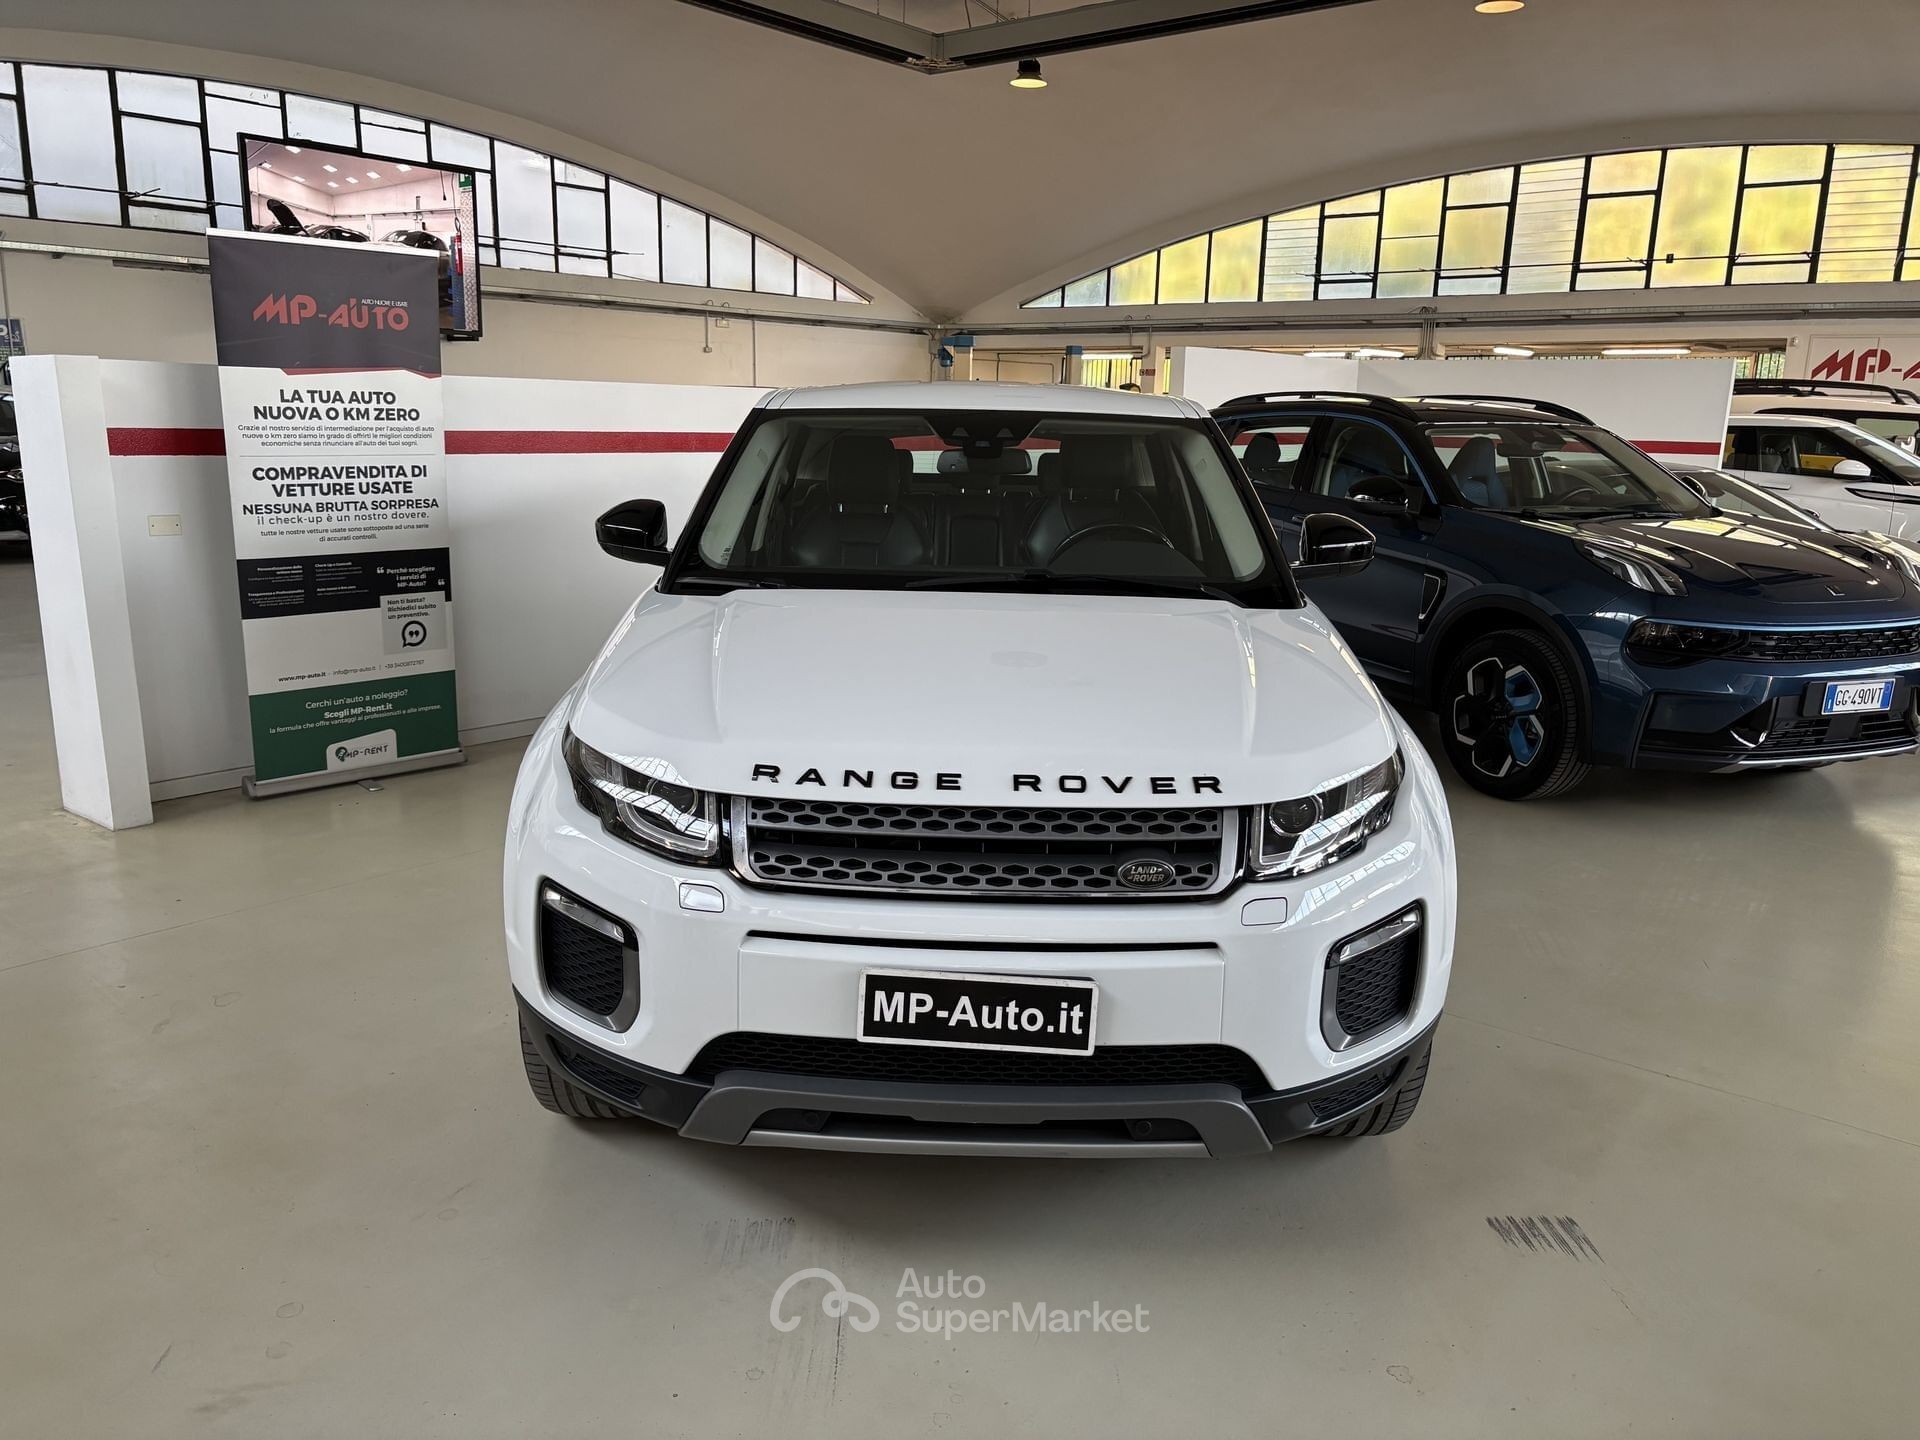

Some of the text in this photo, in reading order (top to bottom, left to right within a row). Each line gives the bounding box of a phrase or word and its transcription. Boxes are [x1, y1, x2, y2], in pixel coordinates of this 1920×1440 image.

[280, 389, 396, 405] LA TUA AUTO
[254, 406, 420, 421] NUOVA O KM ZERO
[252, 465, 427, 480] COMPRAVENDITA DI
[272, 481, 413, 497] VETTURE USATE
[243, 499, 439, 515] NESSUNA BRUTTA SORPRESA
[269, 516, 322, 525] check-up
[326, 514, 333, 522] è
[354, 513, 388, 521] nostro
[392, 511, 429, 520] dovere.
[278, 672, 326, 682] www.mp-auto.it
[306, 699, 332, 710] Cerchi
[334, 694, 364, 706] un'auto
[372, 689, 408, 702] noleggio?
[324, 702, 393, 720] Scegli MP-Rent.it
[276, 724, 302, 733] formula
[316, 719, 330, 727] offre
[331, 716, 357, 726] vantaggi
[751, 763, 1224, 794] RANGE ROVER
[872, 990, 1084, 1035] MP-Auto.it
